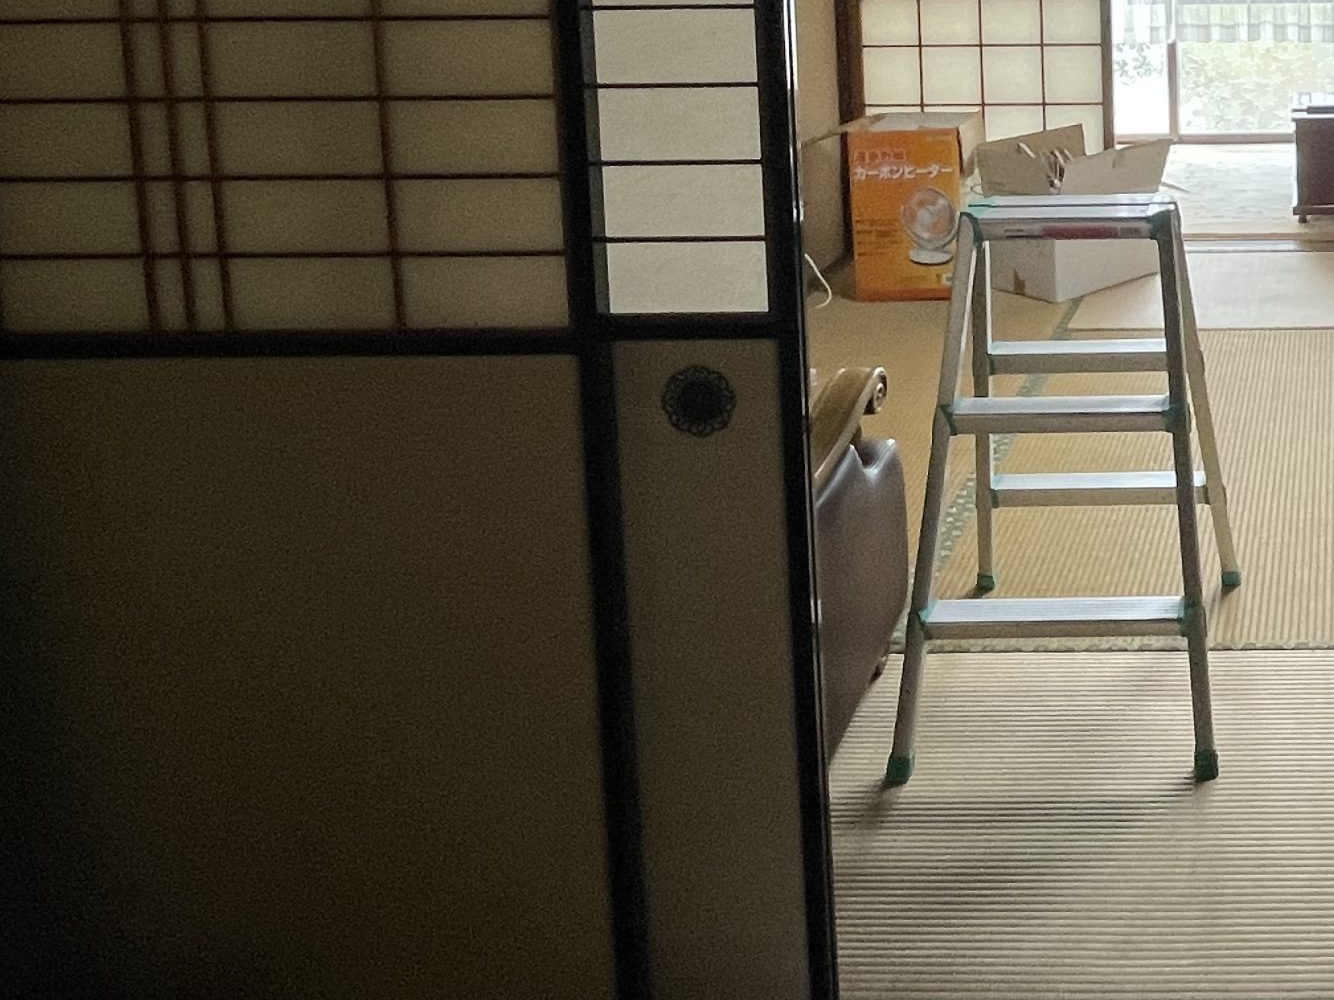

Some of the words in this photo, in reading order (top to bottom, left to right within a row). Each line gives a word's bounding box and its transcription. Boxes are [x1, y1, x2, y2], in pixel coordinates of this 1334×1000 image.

[855, 164, 953, 180] カーボンヒーター
